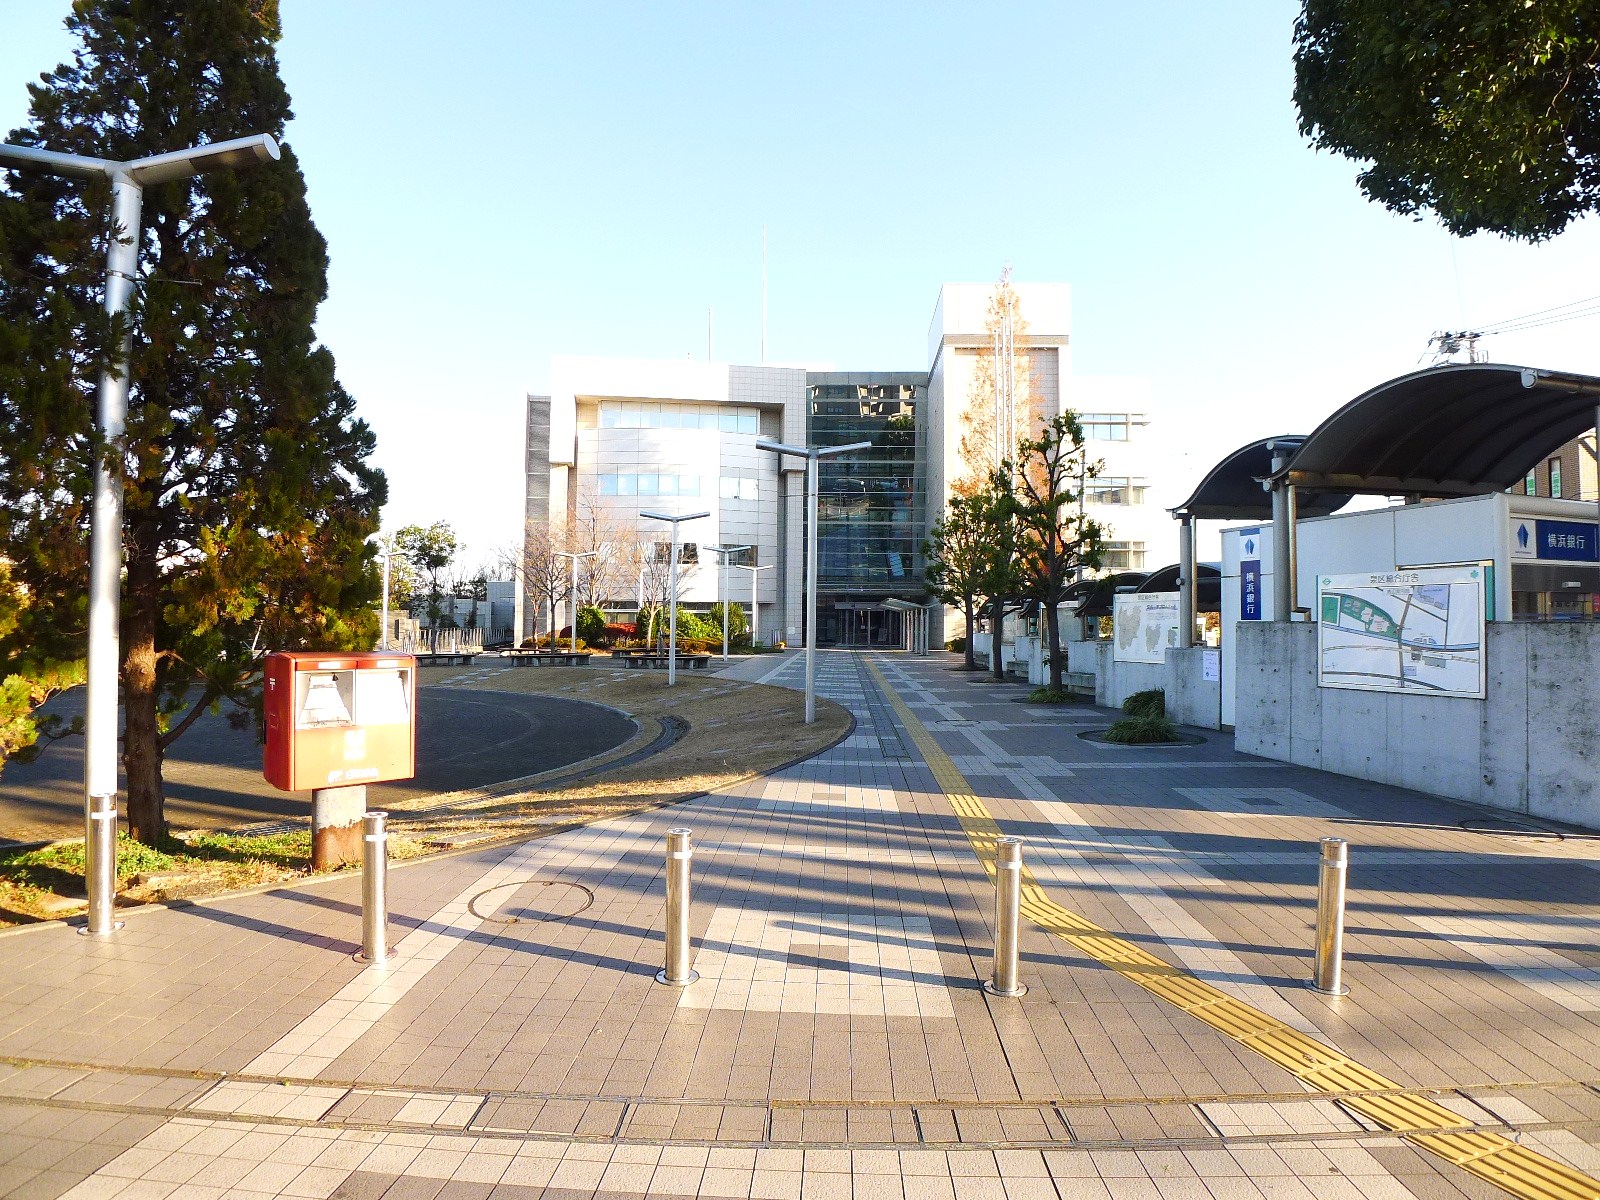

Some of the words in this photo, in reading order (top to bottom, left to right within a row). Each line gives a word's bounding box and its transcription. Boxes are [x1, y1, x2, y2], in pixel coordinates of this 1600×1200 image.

[1548, 533, 1586, 549] 横浜銀行
[1246, 572, 1255, 614] 横浜銀行
